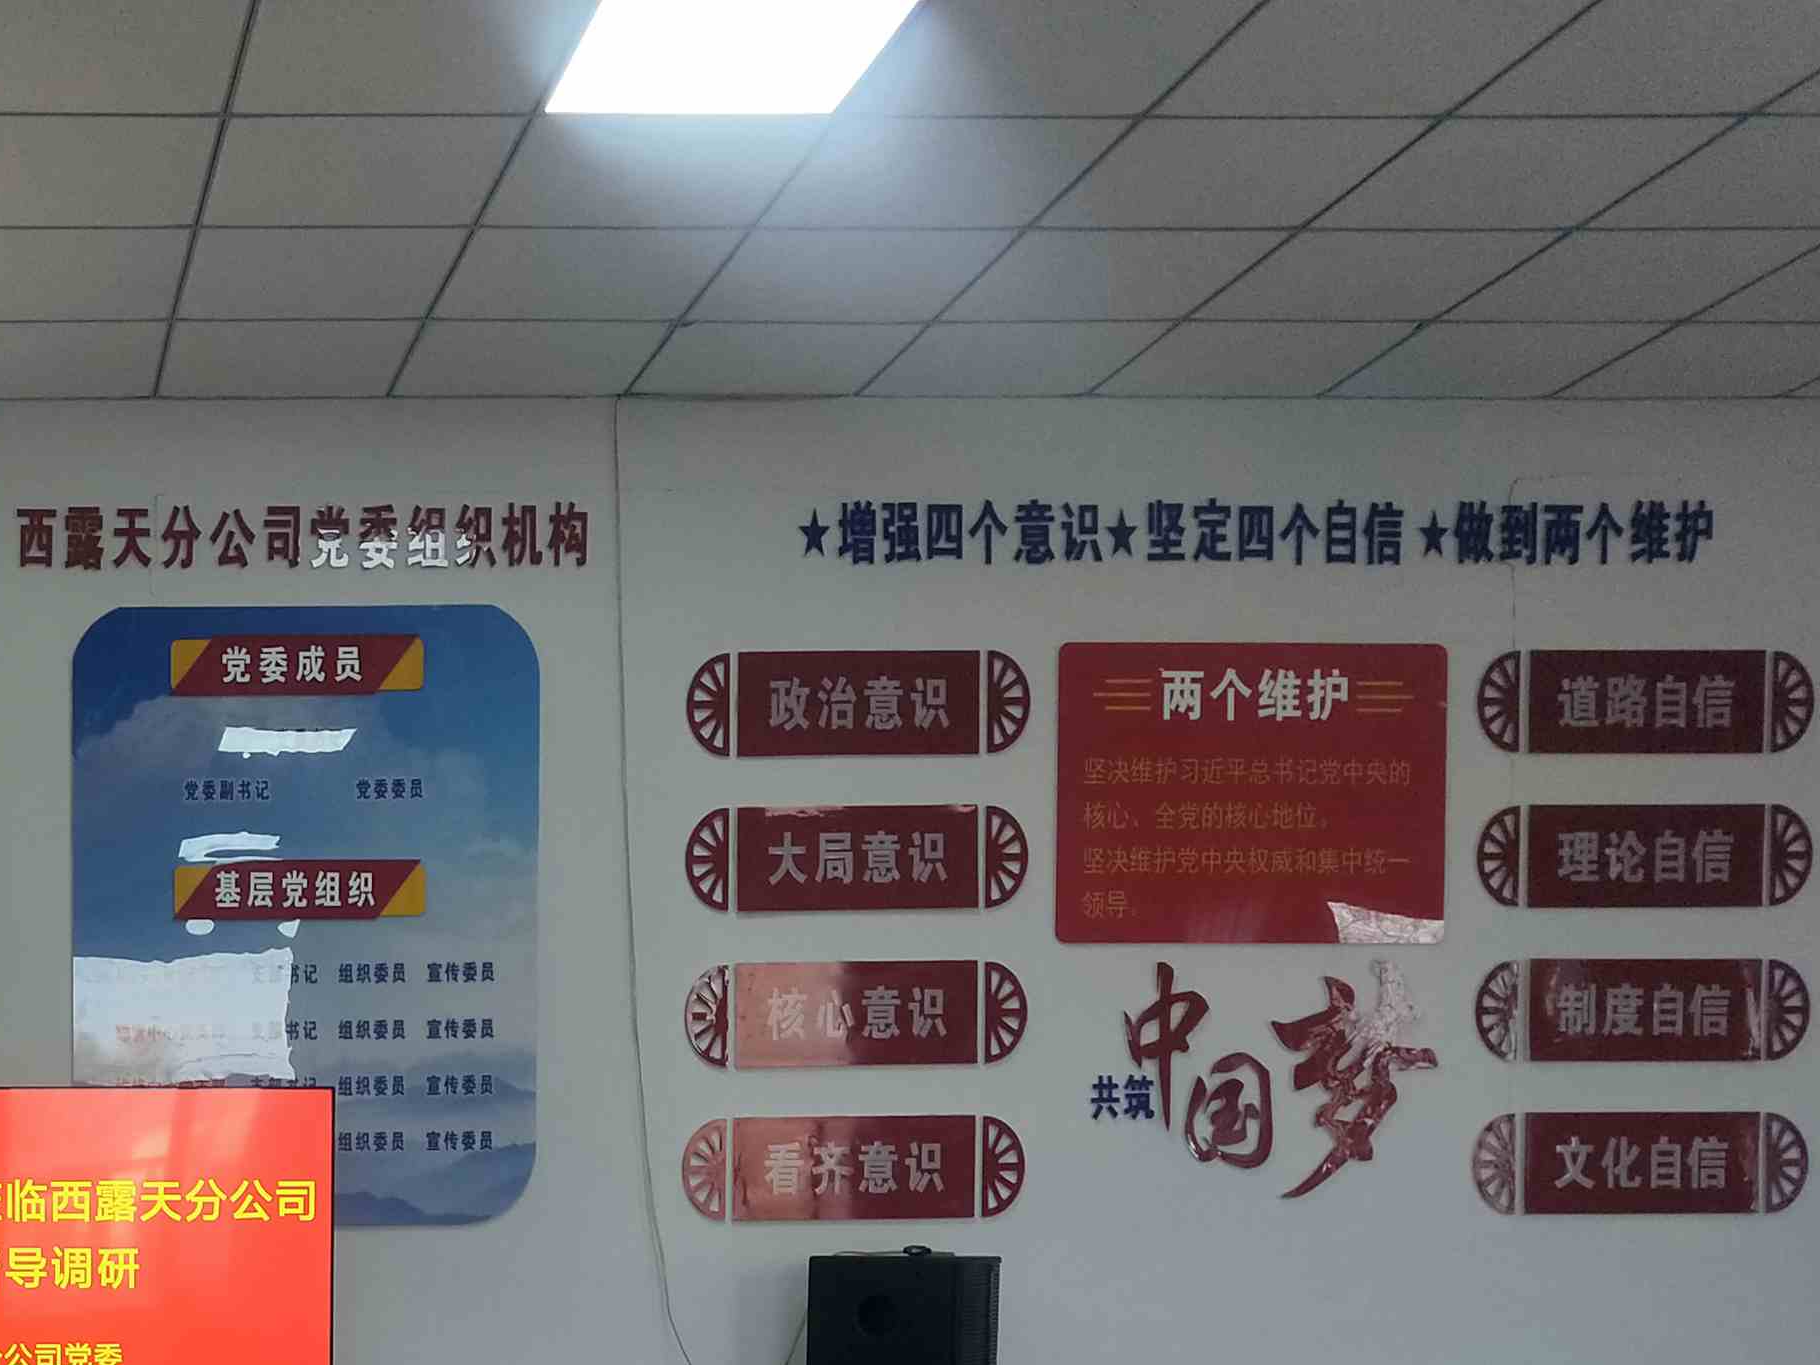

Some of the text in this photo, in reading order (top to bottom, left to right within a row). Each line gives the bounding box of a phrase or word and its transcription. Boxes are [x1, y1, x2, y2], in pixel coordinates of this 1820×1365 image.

[16, 501, 591, 570] 西露天分公司党委组织机构
[837, 499, 1715, 565] 增强四个意识 坚定四个自信 做到两个维护
[221, 645, 364, 684] 党委成员
[768, 676, 952, 732] 政治意识
[1160, 667, 1350, 723] 两个维护
[1557, 674, 1736, 730] 道路自信
[183, 777, 425, 801] 党委副书记 党委委员
[1083, 757, 1413, 786] 坚决维护习近平总书记党中央的
[768, 830, 949, 886] 大局意识
[1083, 848, 1413, 876] 坚决维护党中央权威和集中统一
[1557, 828, 1735, 884] 理论自信
[215, 870, 376, 909] 基层党组织
[337, 962, 407, 985] 组织委员
[426, 961, 496, 984] 宣传委员
[337, 1018, 407, 1041] 组织委员
[426, 1017, 496, 1040] 宣传委员
[766, 985, 948, 1041] 核心意识
[1556, 982, 1732, 1038] 制度自信
[337, 1074, 406, 1098] 组织委员
[425, 1073, 495, 1097] 宣传委员
[1089, 1074, 1156, 1121] 共筑
[337, 1129, 494, 1154] 组织委员 宣传委员
[763, 1140, 946, 1196] 看齐意识
[1554, 1135, 1730, 1190] 文化自信
